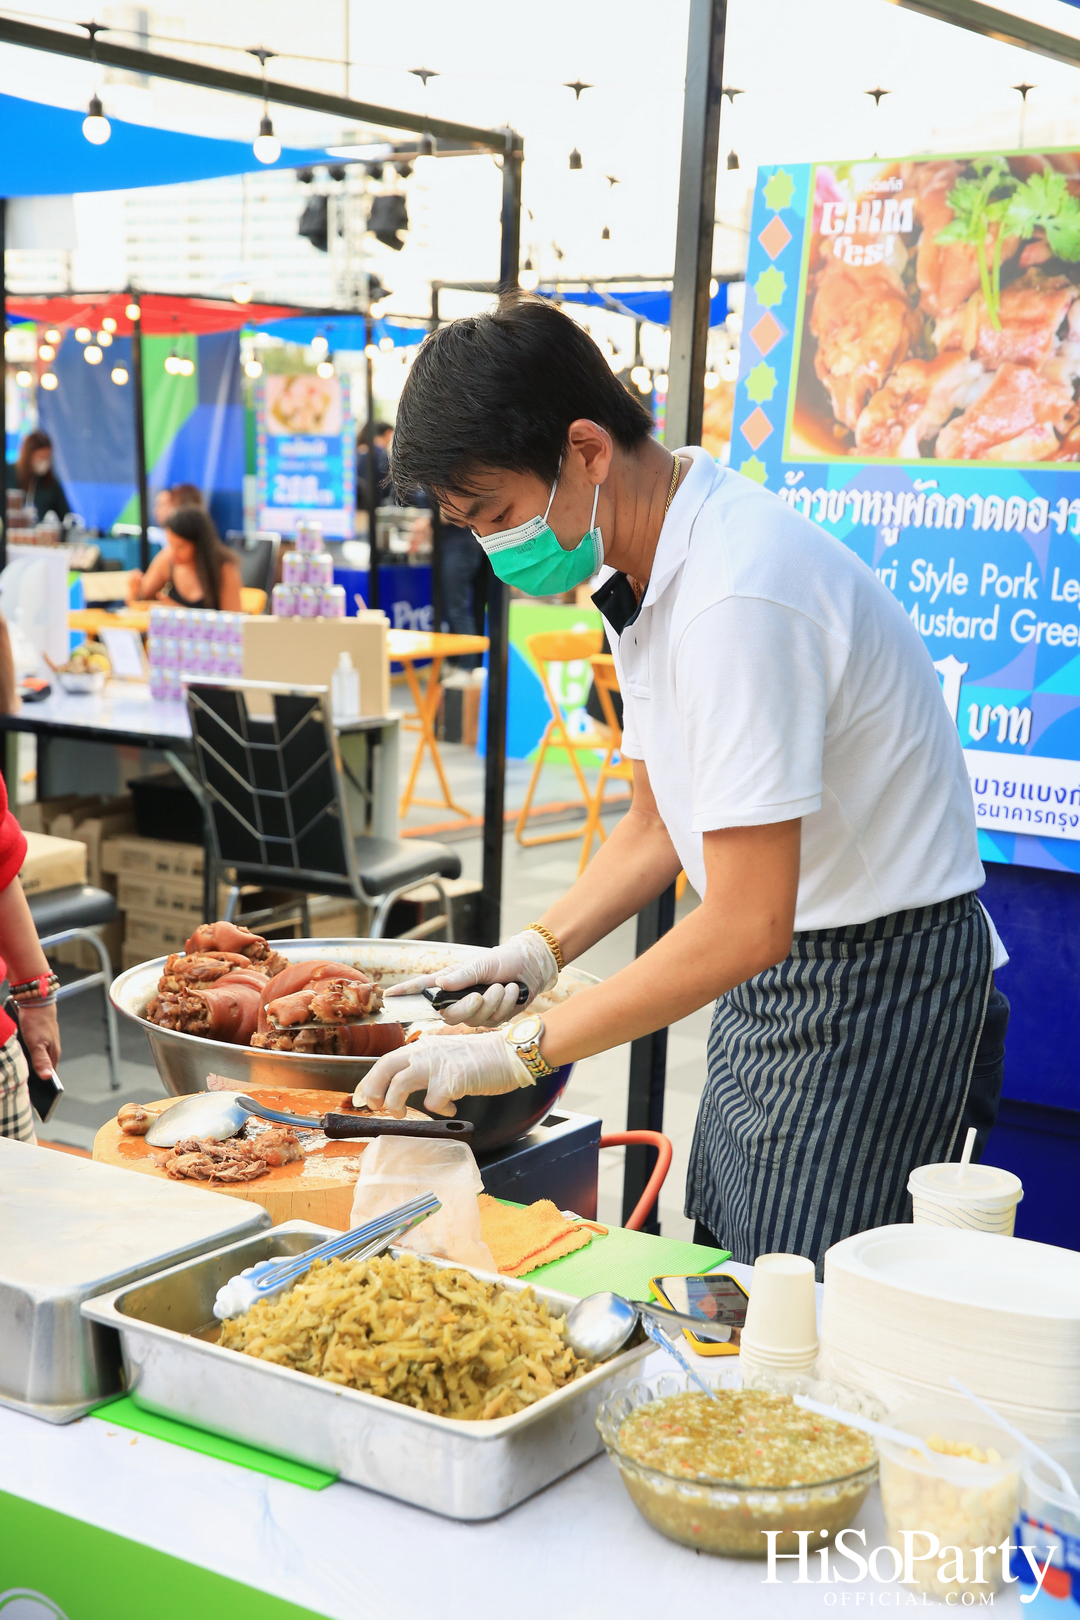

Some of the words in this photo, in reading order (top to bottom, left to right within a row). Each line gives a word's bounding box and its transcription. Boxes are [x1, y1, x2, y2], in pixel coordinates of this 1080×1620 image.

[909, 558, 969, 604] Style
[980, 562, 1039, 600] Pork
[1051, 566, 1080, 612] Le
[1010, 608, 1080, 647] Gree
[967, 702, 1033, 746] บาท
